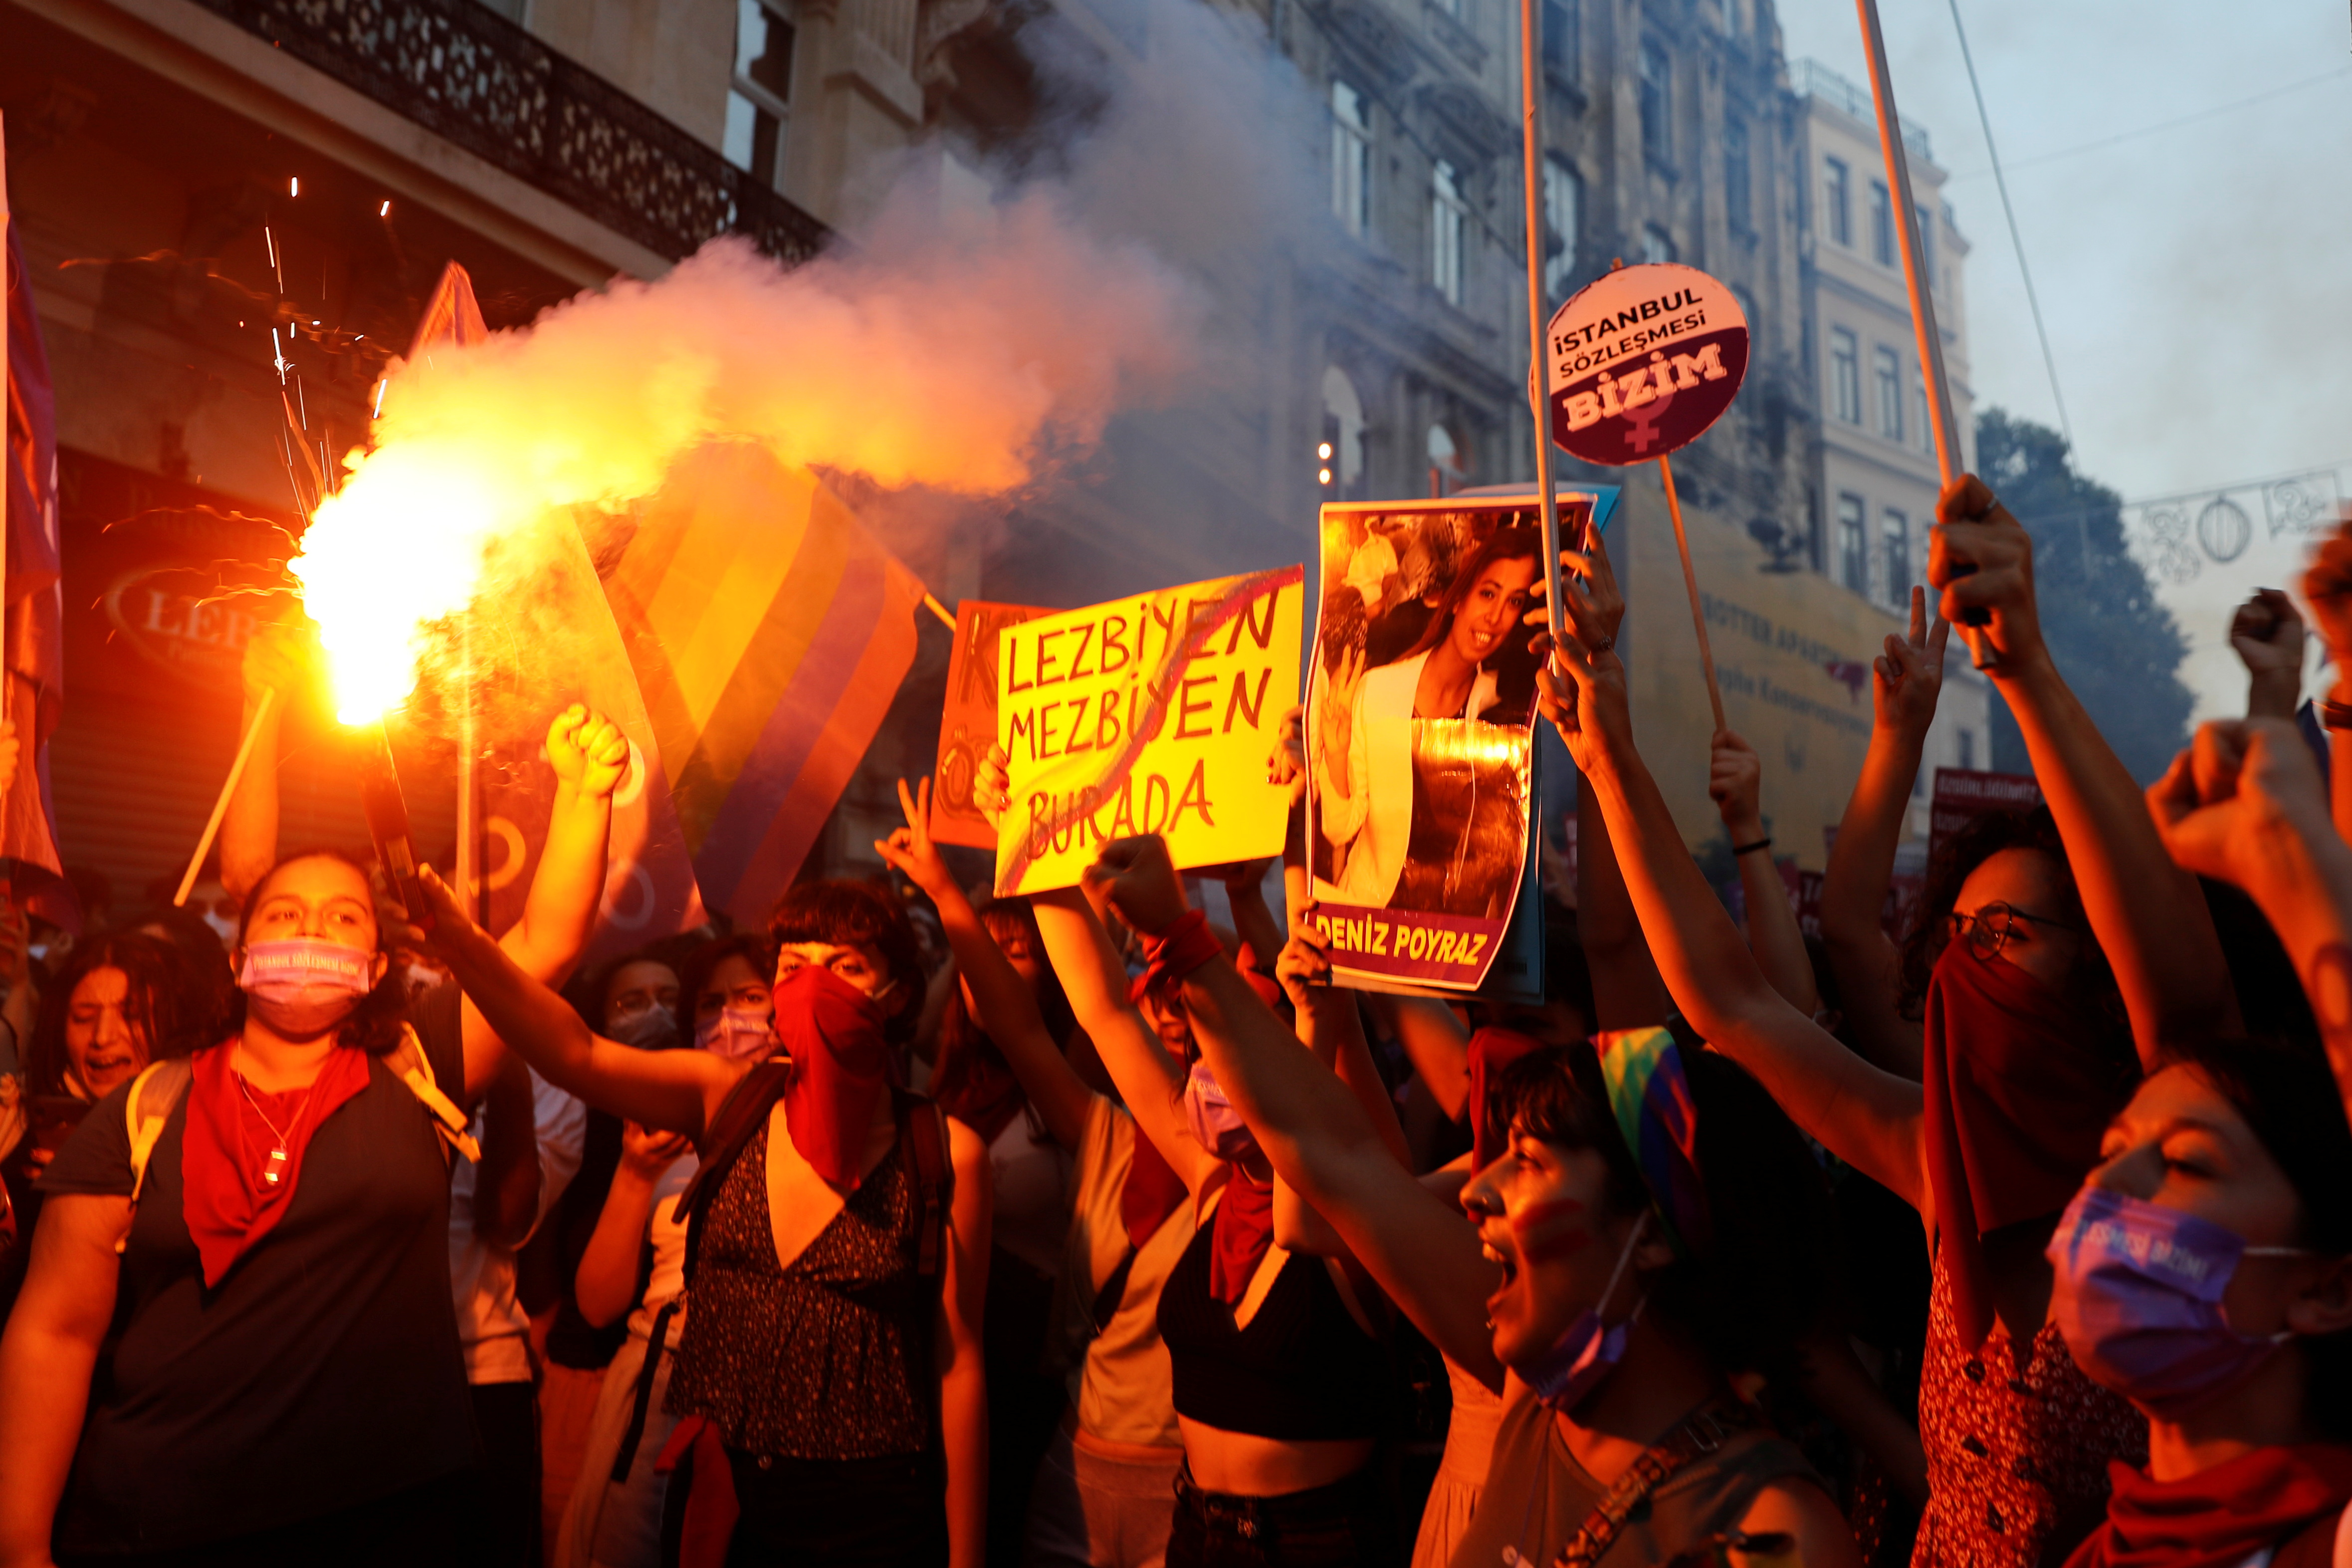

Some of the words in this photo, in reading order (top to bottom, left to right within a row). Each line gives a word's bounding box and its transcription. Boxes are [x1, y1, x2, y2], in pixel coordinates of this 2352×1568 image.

[1553, 288, 1703, 356] İSTANBUL
[1560, 309, 1706, 379] SÖZLEŞMESİ
[1562, 343, 1727, 432] BİZİM
[1008, 586, 1279, 695] LEZBİYEN
[1008, 669, 1271, 763] MEZBİYEN
[1028, 758, 1215, 860] BURADA
[1316, 913, 1389, 956] DENİZ
[1394, 924, 1488, 966] POYRAZ
